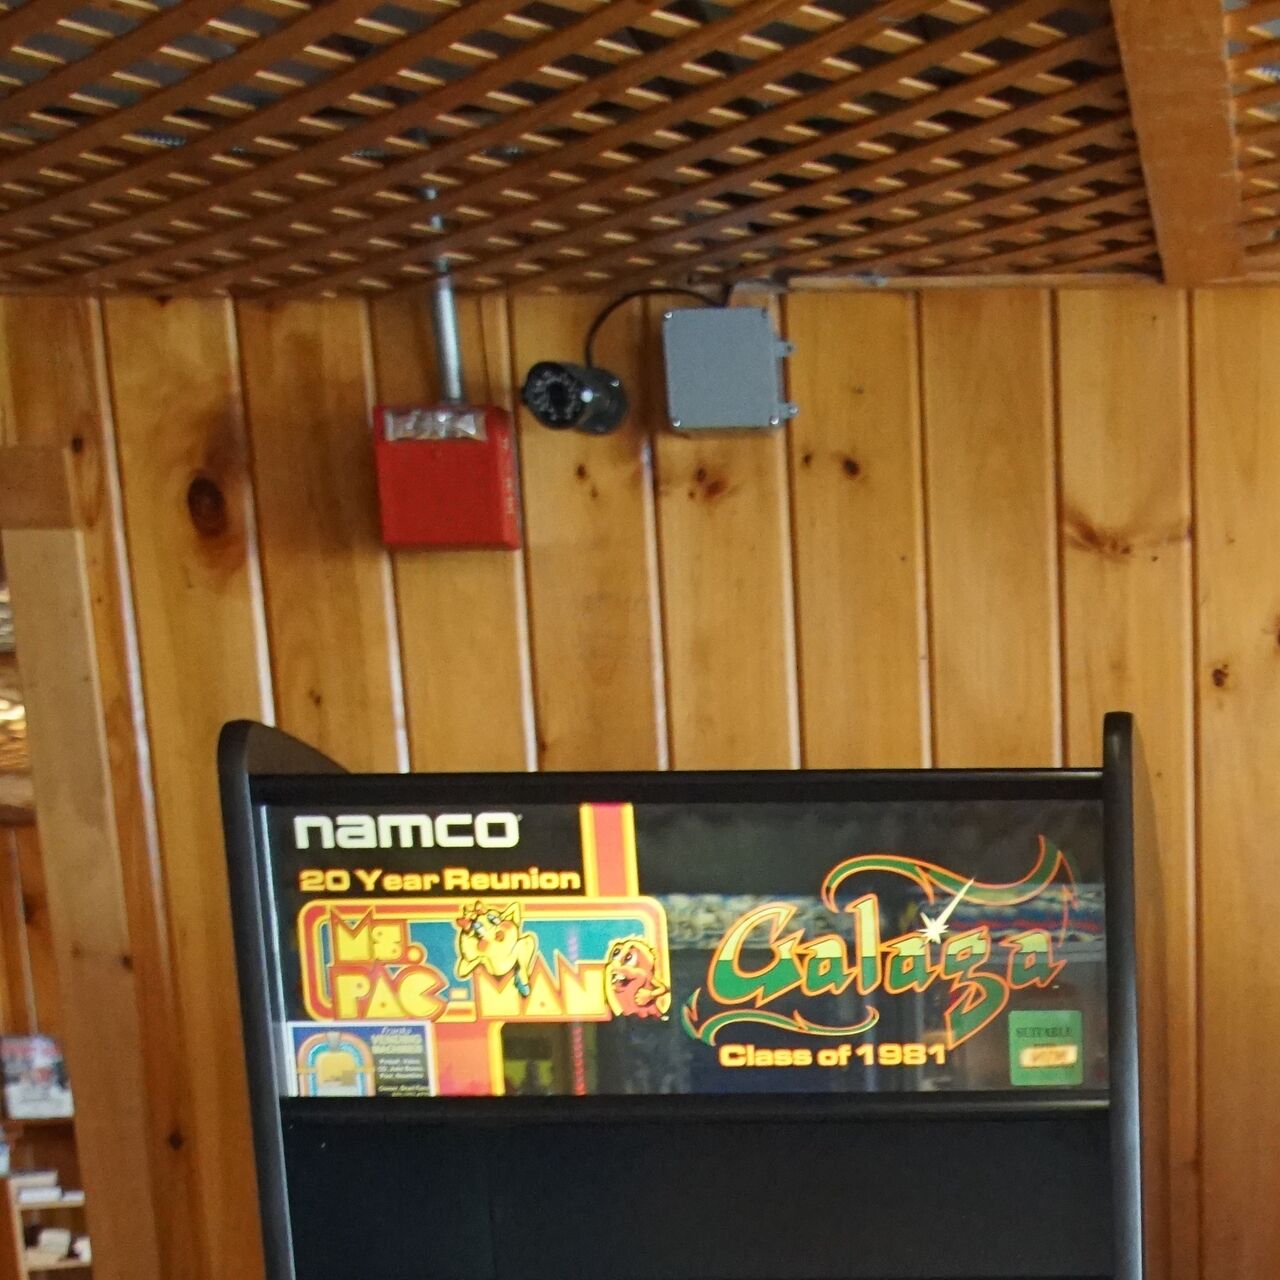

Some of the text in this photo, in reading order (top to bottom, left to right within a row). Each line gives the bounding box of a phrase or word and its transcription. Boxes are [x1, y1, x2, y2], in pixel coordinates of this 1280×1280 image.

[294, 812, 520, 849] namco
[300, 866, 581, 891] 20 Year Reunion
[707, 893, 1066, 1052] Galaga
[718, 1043, 948, 1067] Class of 1981
